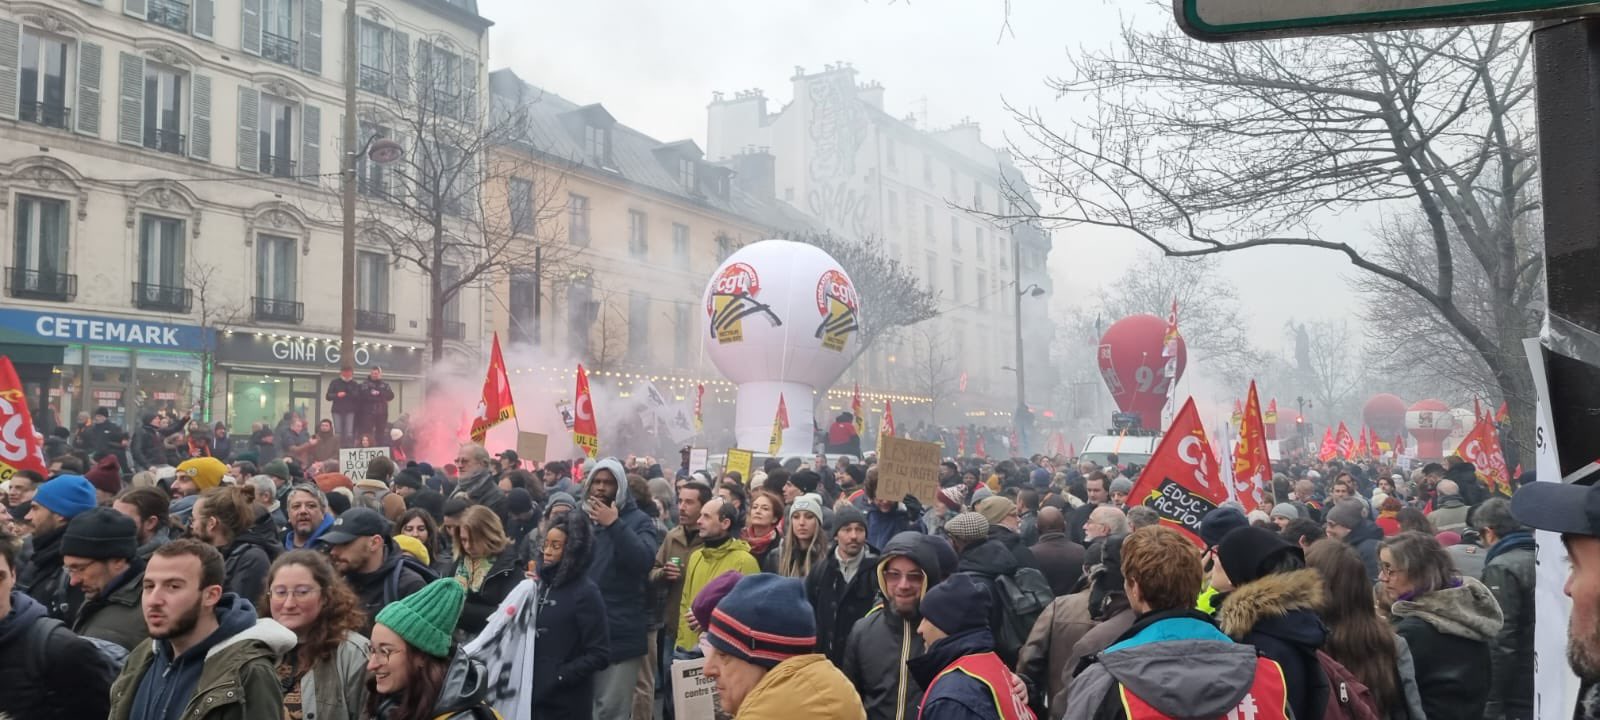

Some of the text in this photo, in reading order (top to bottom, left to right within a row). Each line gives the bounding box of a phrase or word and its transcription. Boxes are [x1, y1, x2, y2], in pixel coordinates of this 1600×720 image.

[35, 315, 180, 346] CETEMARK
[272, 340, 370, 366] GINA GO
[684, 687, 709, 698] contre
